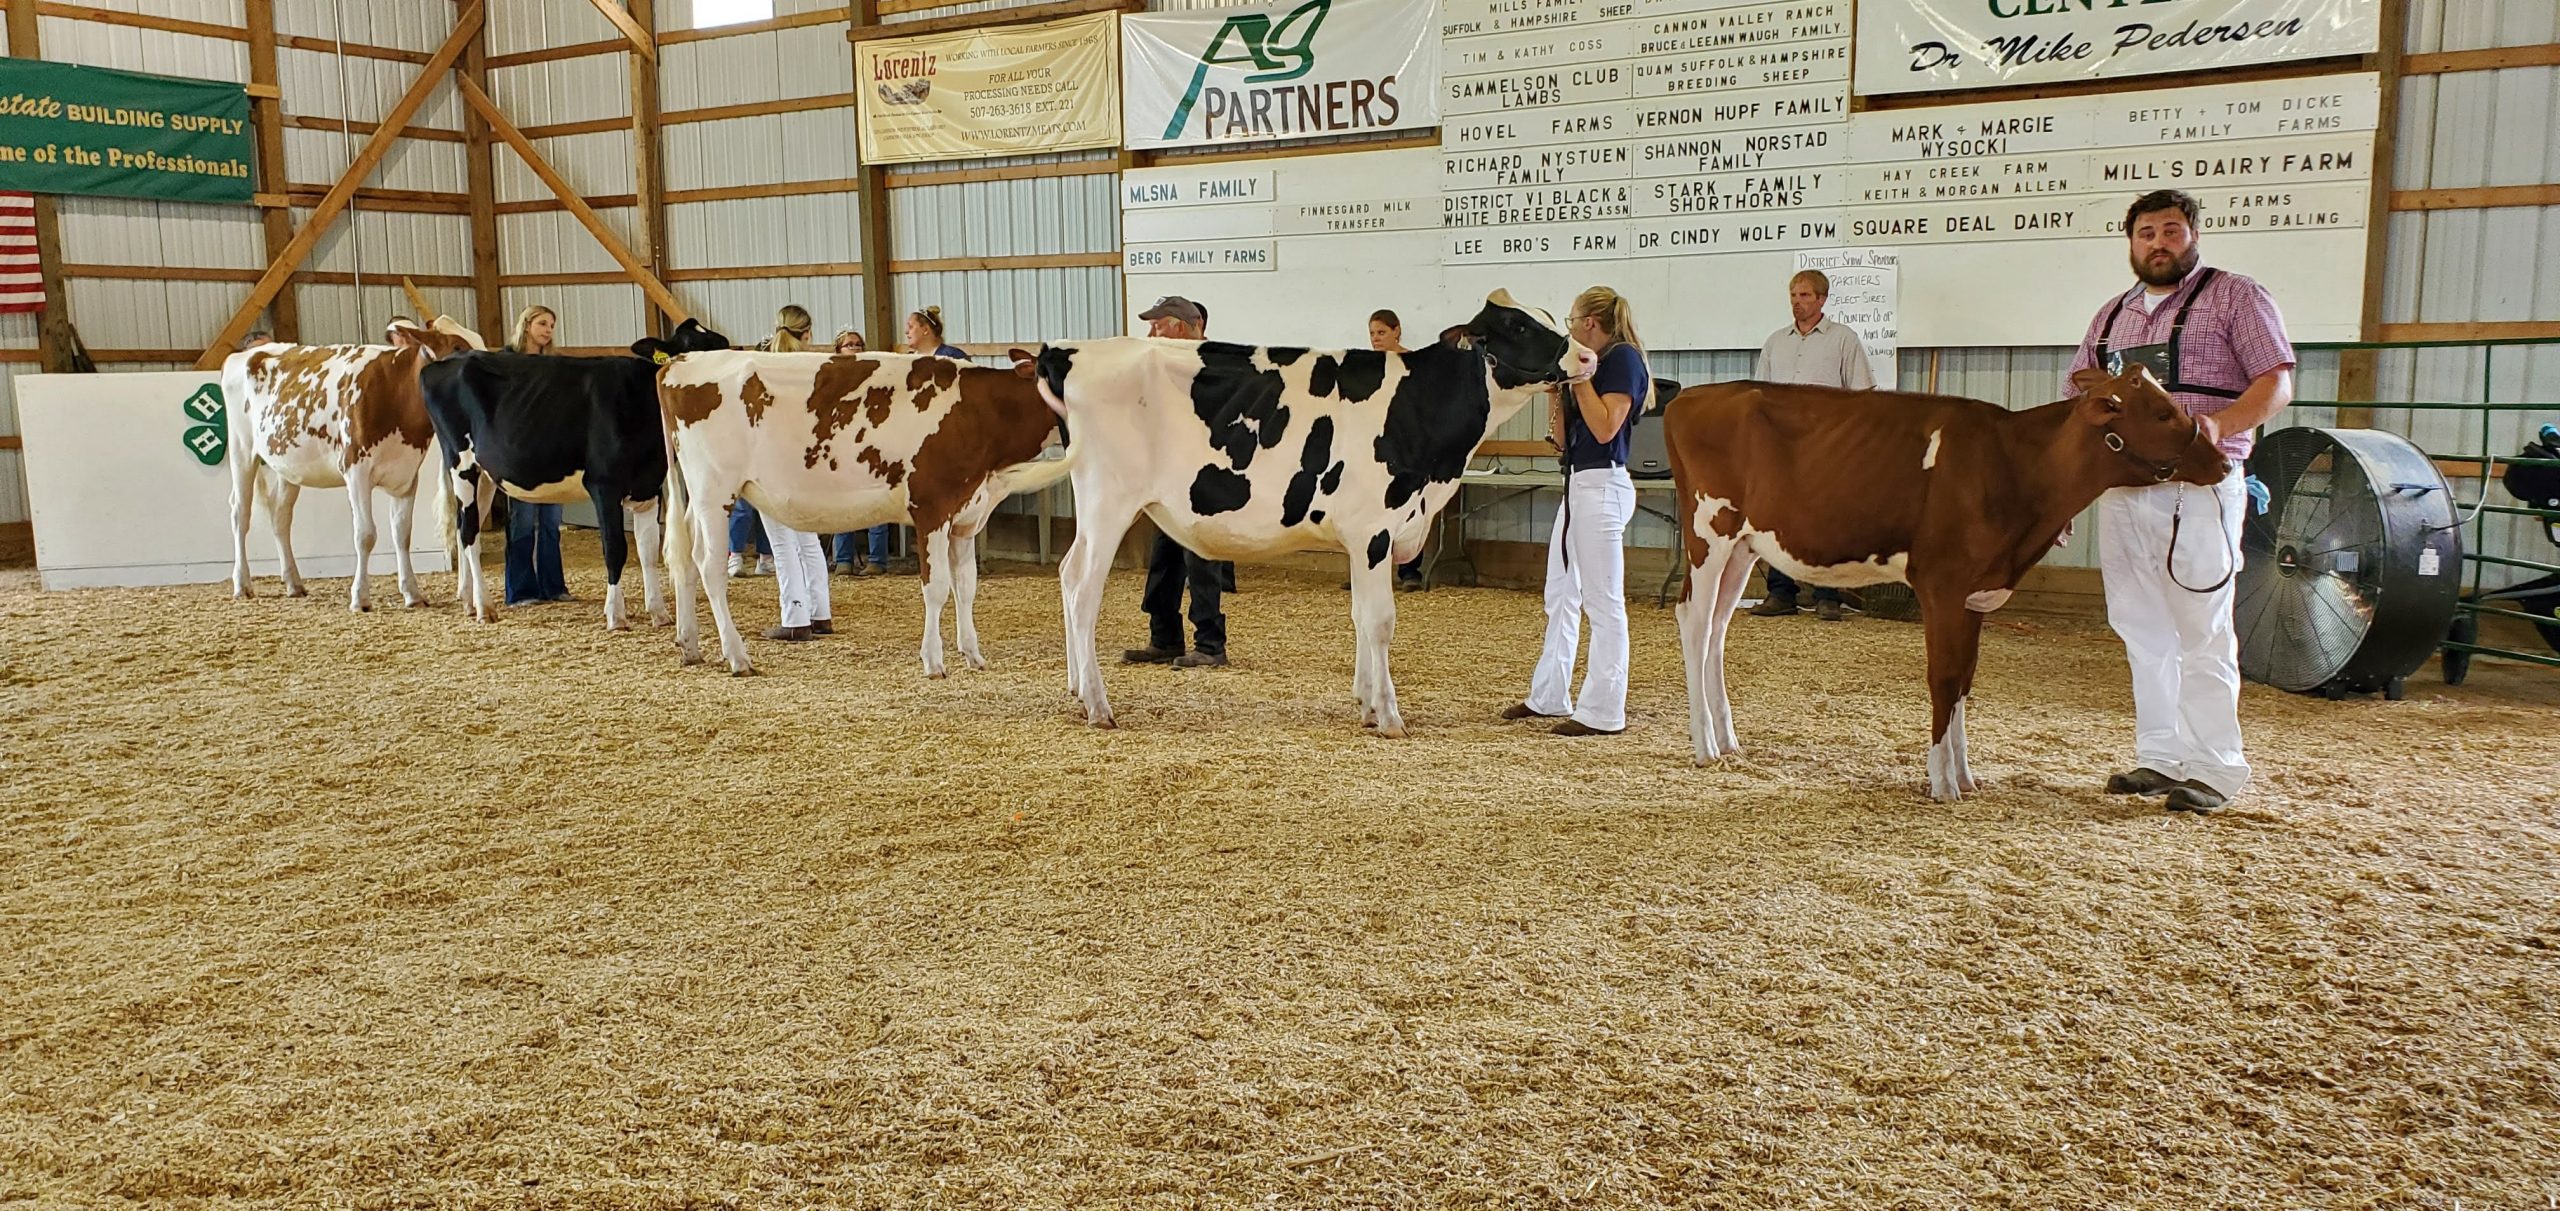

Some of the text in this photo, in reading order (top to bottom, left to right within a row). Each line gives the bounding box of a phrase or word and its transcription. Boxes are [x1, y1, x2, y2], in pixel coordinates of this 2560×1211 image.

[1490, 0, 1527, 13] MILLS
[1443, 21, 1481, 36] SUFFOLK
[1494, 20, 1500, 29] &
[1511, 11, 1577, 28] HAMPSHIRE
[1654, 5, 1833, 34] CANNON VALLEY RANCH
[945, 50, 979, 62] WORKING
[980, 48, 1000, 58] WITH
[1000, 45, 1025, 56] LOCAL
[1025, 41, 1058, 54] FARMERS
[1058, 38, 1078, 48] SINCE
[1463, 39, 1602, 64] TIM & KATHY COSS
[1641, 39, 1678, 54] BRUCE
[1689, 33, 1734, 49] LEEANN
[1739, 29, 1779, 44] WAUGH
[1909, 14, 2303, 72] Dr Mike Pedersen
[873, 50, 936, 81] Lorentz
[1637, 47, 1845, 77] QUAM SUFFOLK & HAMPSHIRE
[988, 67, 1052, 84] FOR ALL YOUR
[1452, 68, 1619, 98] SAMMELSON CLUB
[1669, 68, 1810, 92] BREEDING SHEEP
[963, 80, 1079, 101] PROCESSING NEEDS CALL
[1502, 89, 1561, 108] LAMBS
[970, 98, 1074, 119] 507-263-3618 EXT. 221
[1204, 75, 1400, 139] PARTNERS
[1636, 96, 1844, 127] VERNON HUPF FAMILY
[2129, 107, 2183, 123] BETTY
[2226, 101, 2261, 116] TOM
[2282, 95, 2343, 111] DICKE
[67, 104, 164, 129] BUILDING
[170, 114, 243, 136] SUPPLY
[1461, 115, 1613, 142] HOVEL FARMS
[1892, 123, 1943, 143] MARK
[1981, 116, 2055, 136] MARGIE
[2160, 116, 2341, 140] FAMILY FARMS
[1644, 132, 1827, 160] SHANNON NORSTAD
[1921, 138, 2007, 158] WYSOCKI
[34, 144, 57, 163] of
[63, 145, 101, 166] the
[106, 148, 248, 178] Professionals
[1446, 147, 1626, 174] RICHARD NYSTUEN
[1699, 153, 1764, 172] FAMILY
[1883, 161, 2048, 182] HAY CREEK FARM
[2104, 152, 2352, 181] MILL'S DAIRY FARM
[1497, 168, 1564, 185] FAMILY
[1654, 174, 1821, 199] STARK FAMILY
[1130, 178, 1257, 202] MLSNA FAMILY
[1445, 193, 1513, 212] DISTRICT
[1553, 188, 1610, 205] BLACK
[1618, 187, 1627, 201] &
[1670, 191, 1803, 213] SHORTHORNS
[1864, 179, 2068, 201] KEITH & MORGAN ALLEN
[2230, 194, 2292, 209] FARMS
[1300, 201, 1412, 217] FINNESGARD MILK
[1444, 204, 1629, 228] WHITE BREEDERS ASSN
[2204, 212, 2339, 228] OUND BALING
[1327, 218, 1385, 230] TRANSFER
[1671, 228, 1720, 245] CINDY
[1740, 224, 1787, 242] WOLF
[1801, 223, 1836, 239] DVM
[1853, 211, 2075, 236] SQUARE DEAL DAIRY
[1455, 235, 1616, 255] LEE BRO'S FARM
[1130, 249, 1266, 266] BERG FAMILY FARMS
[1830, 275, 1881, 289] PARTNERS
[1829, 294, 1860, 306] SELECT
